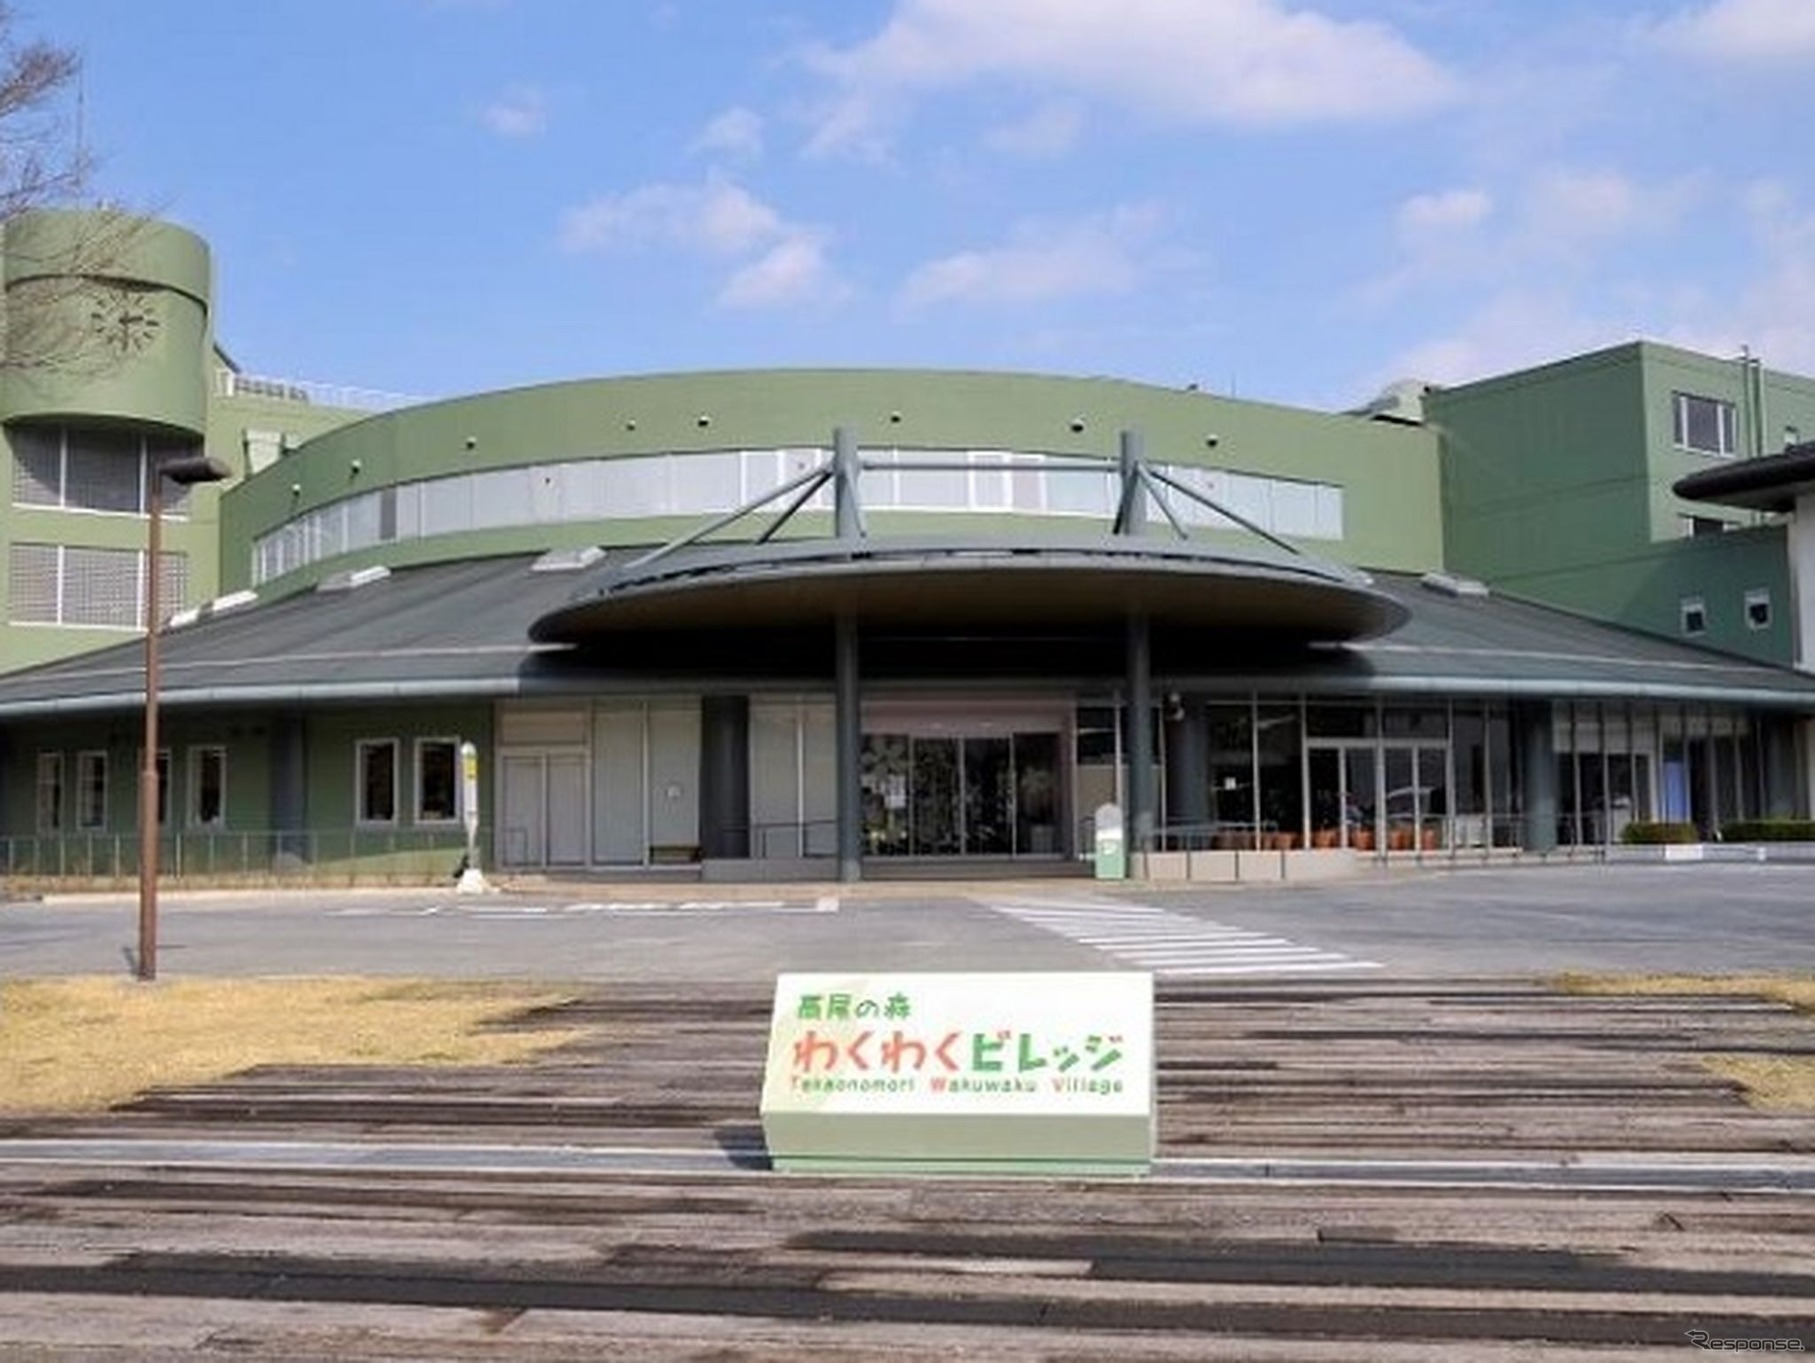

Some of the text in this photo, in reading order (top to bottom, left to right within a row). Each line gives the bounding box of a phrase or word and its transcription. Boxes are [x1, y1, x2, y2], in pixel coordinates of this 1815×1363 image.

[793, 1029, 1124, 1073] わくわくビレッジ
[930, 1076, 1037, 1093] Wakuwaku
[1052, 1076, 1123, 1096] Village
